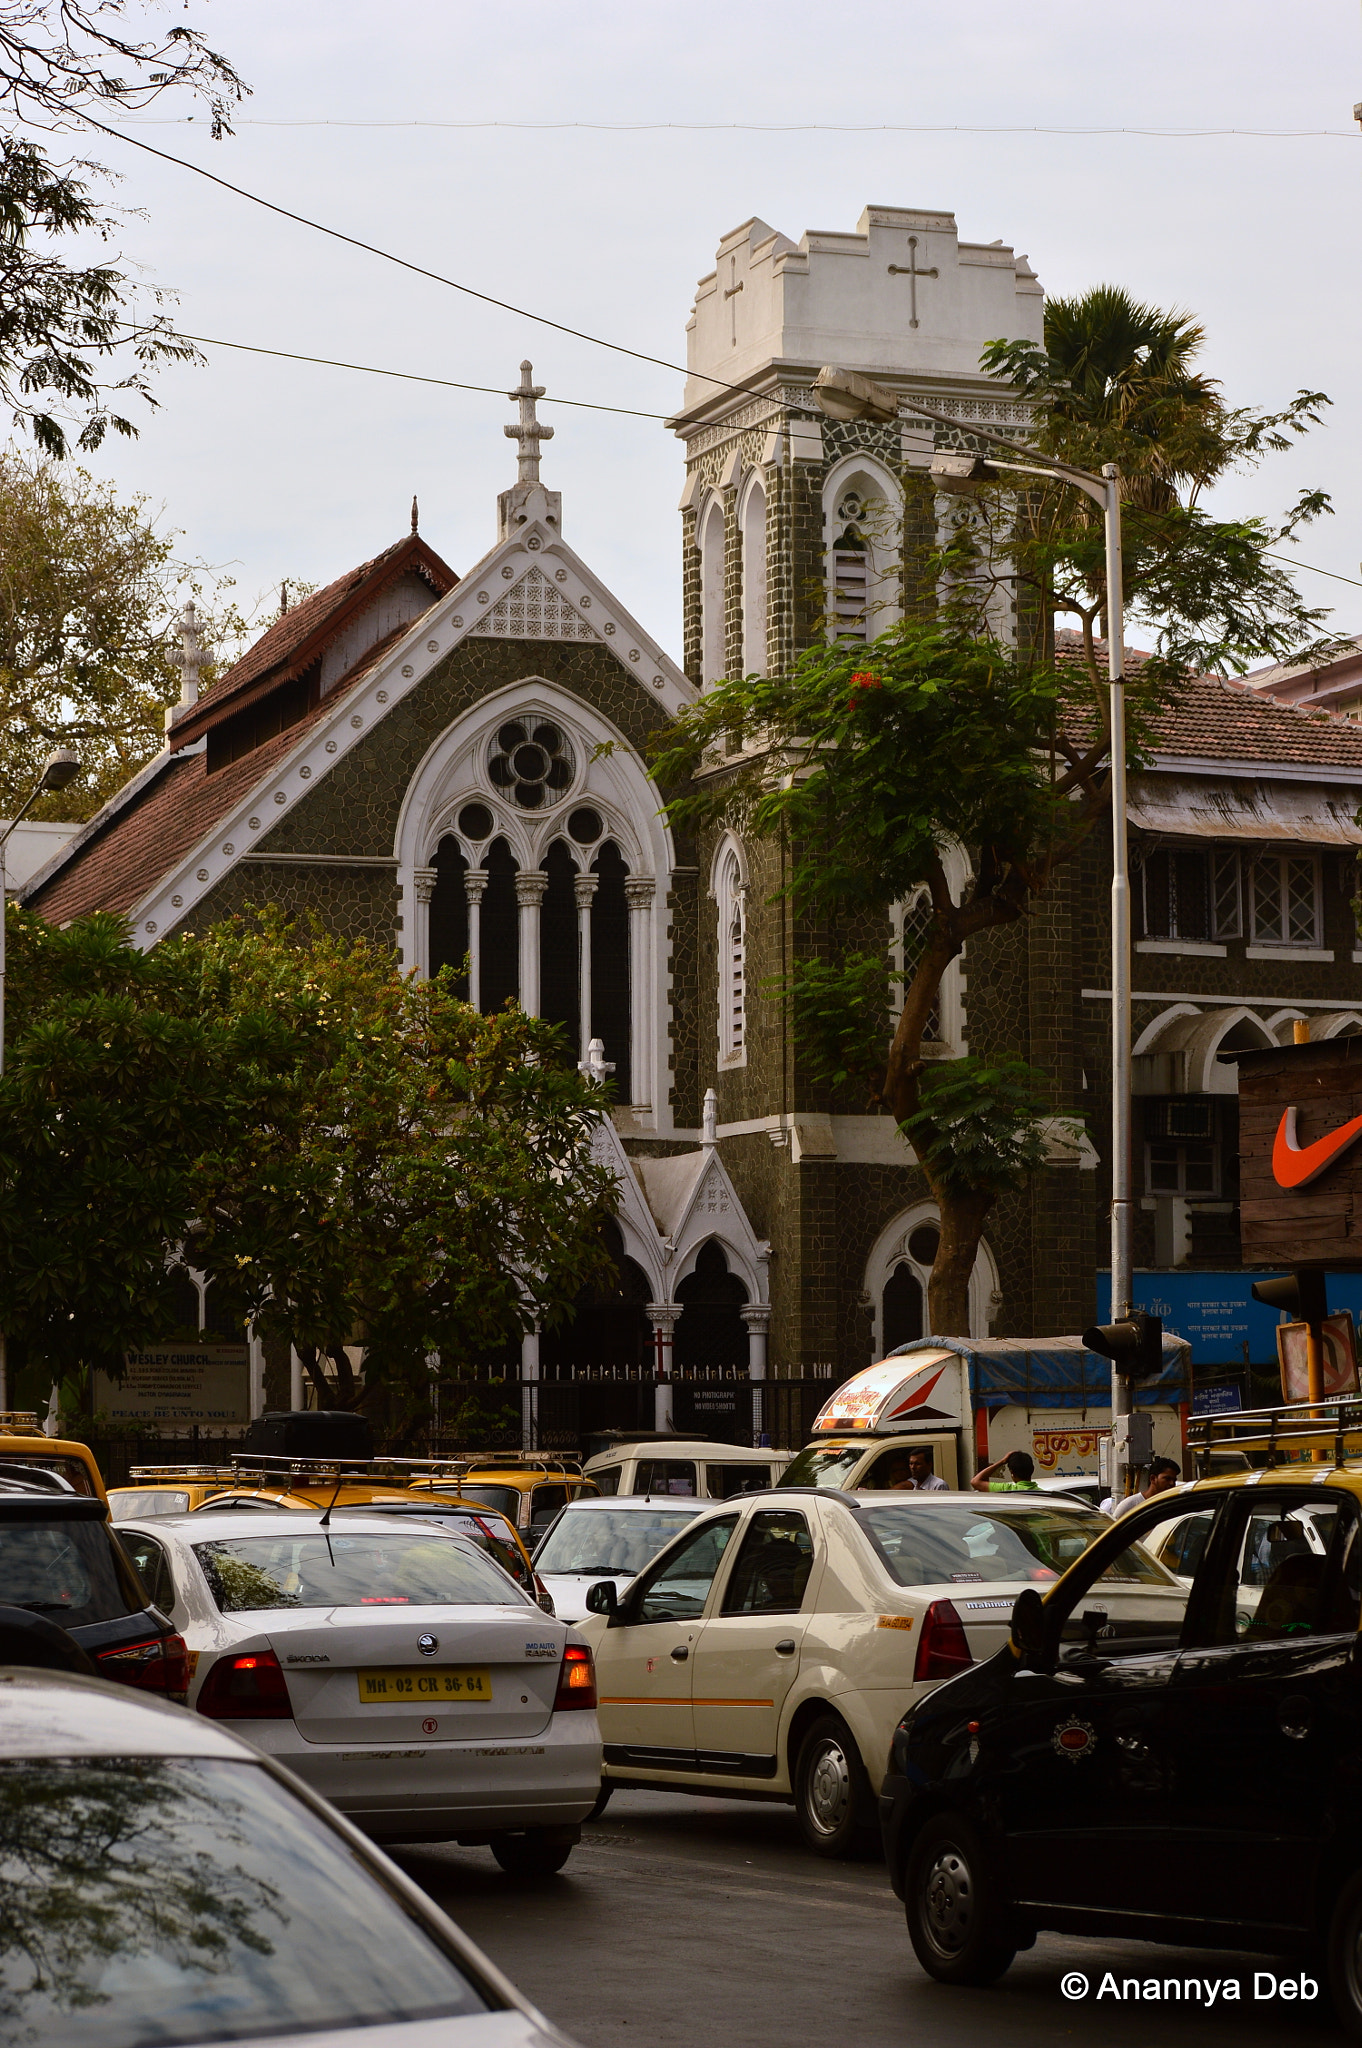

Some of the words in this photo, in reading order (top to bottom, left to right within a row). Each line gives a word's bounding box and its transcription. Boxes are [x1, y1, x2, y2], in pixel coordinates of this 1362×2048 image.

[127, 1354, 169, 1365] WESLEY
[171, 1354, 208, 1365] CHURCH
[577, 1369, 650, 1381] WESLEY
[672, 1369, 745, 1381] CHURCH
[418, 1678, 438, 1692] CR
